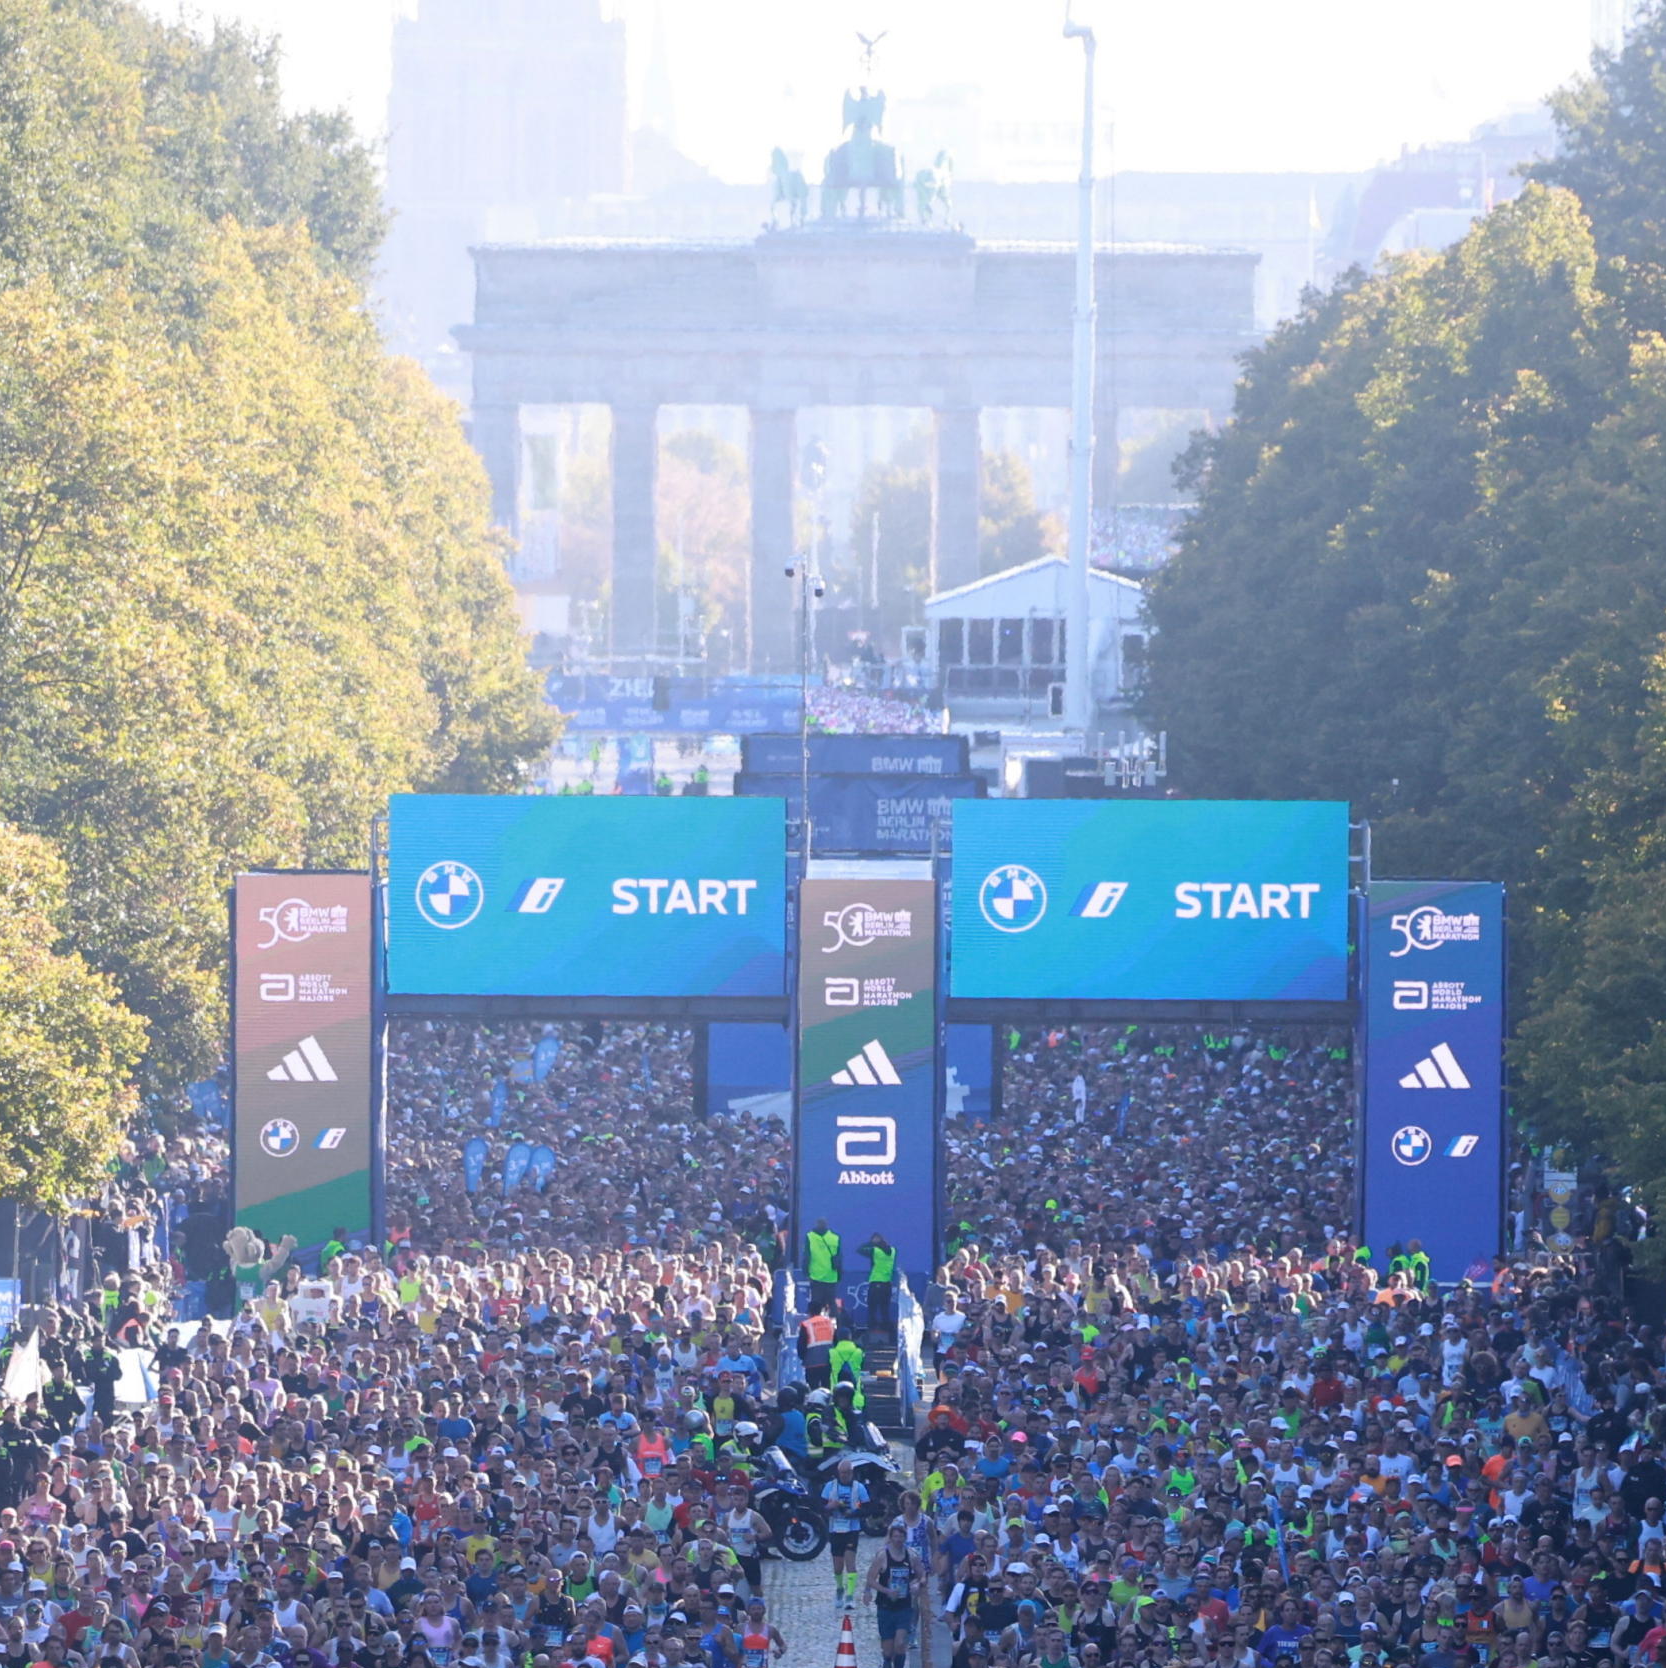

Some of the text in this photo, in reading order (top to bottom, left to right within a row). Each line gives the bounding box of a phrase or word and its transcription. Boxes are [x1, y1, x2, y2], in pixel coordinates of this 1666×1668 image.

[872, 757, 914, 772] BMW
[877, 799, 925, 815] BMW
[877, 816, 925, 828] BERLIN
[611, 878, 757, 915] START
[1175, 882, 1320, 919] START
[299, 907, 330, 918] BMW
[864, 911, 893, 922] BMW
[1432, 915, 1463, 925] BMW
[837, 1170, 895, 1184] Abbott
